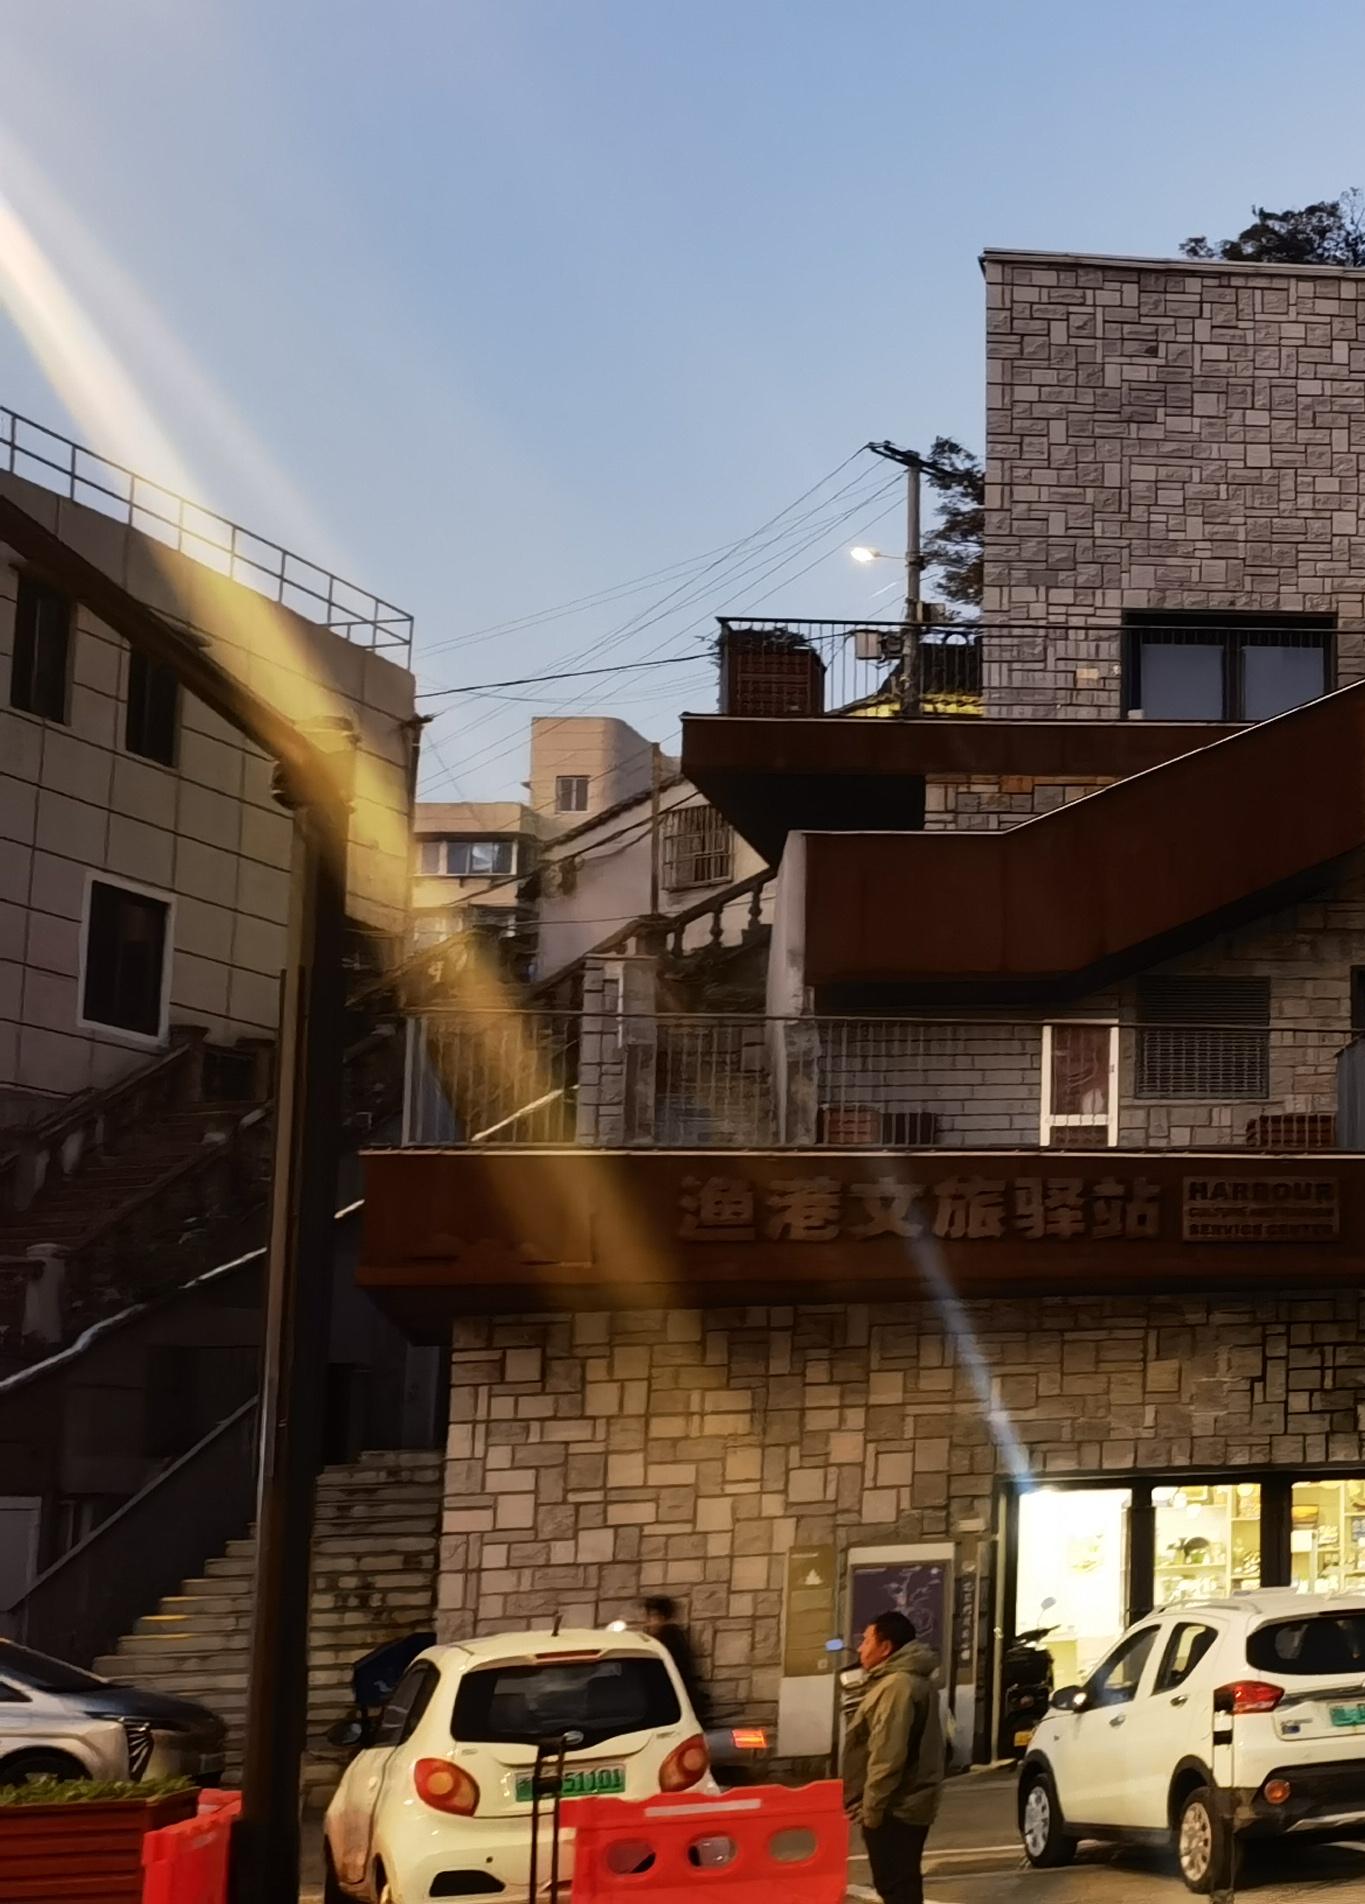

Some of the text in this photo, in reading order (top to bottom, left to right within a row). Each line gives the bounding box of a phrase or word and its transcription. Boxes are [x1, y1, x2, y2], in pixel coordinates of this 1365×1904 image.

[677, 1174, 1162, 1243] 渔港文旅驿站
[1189, 1181, 1335, 1201] HARBOUR
